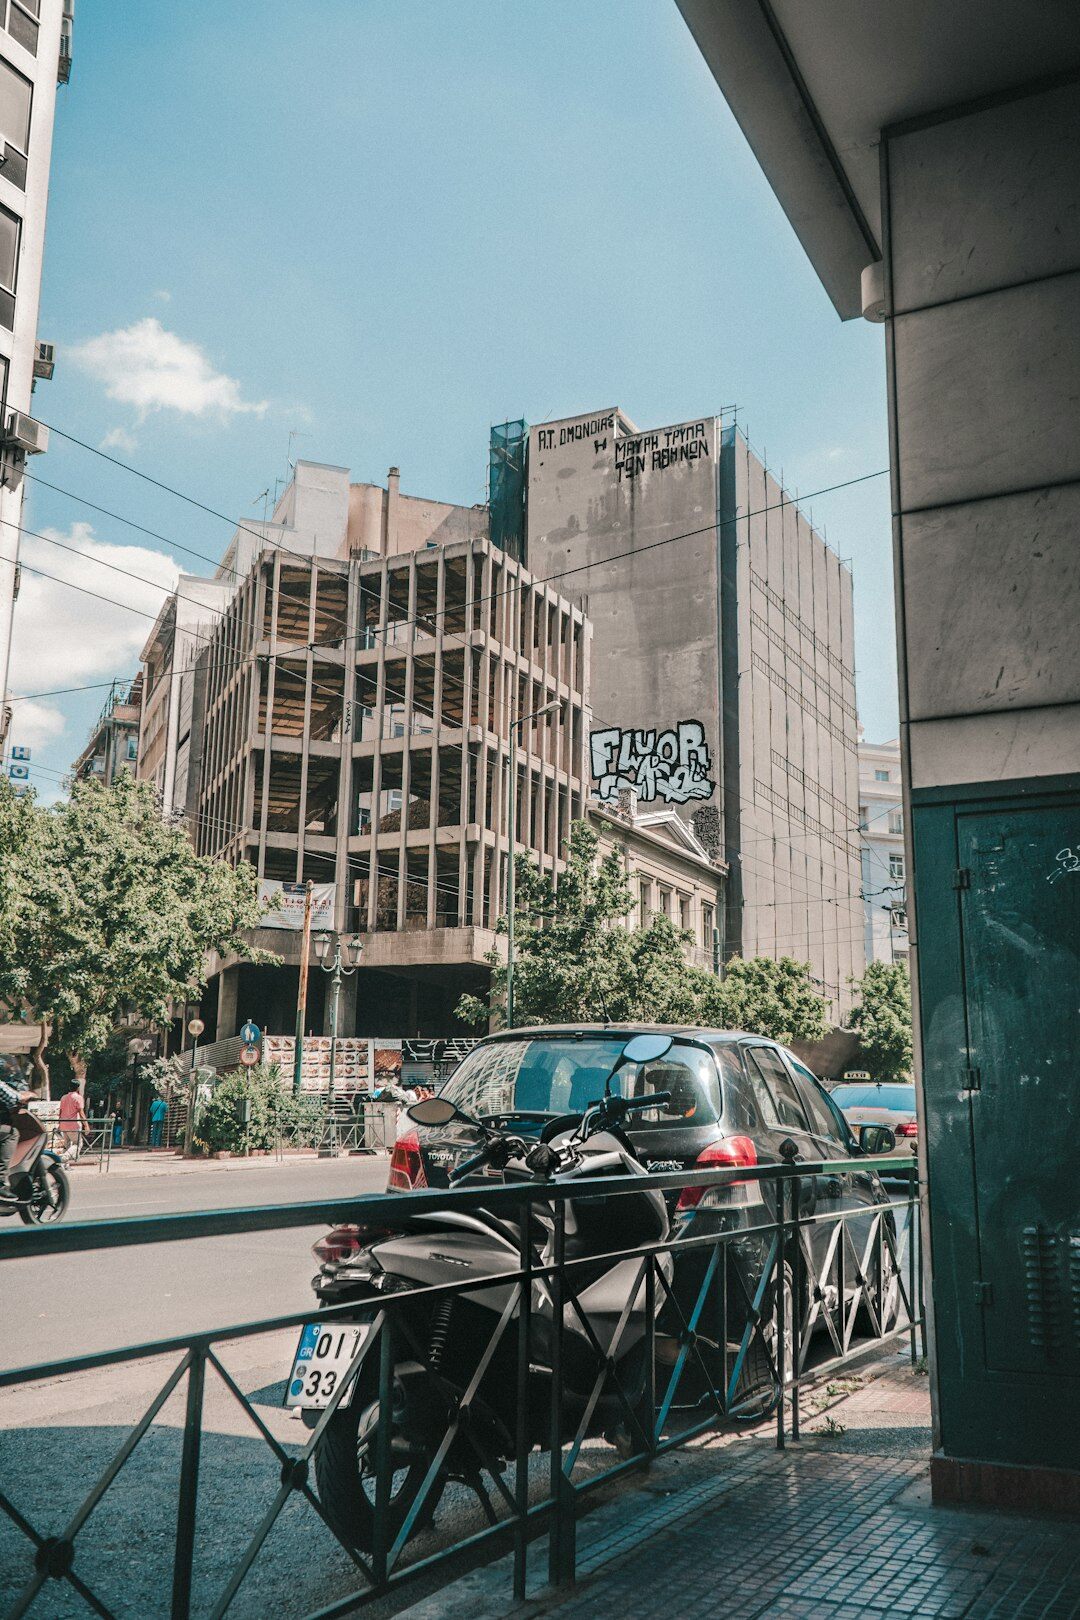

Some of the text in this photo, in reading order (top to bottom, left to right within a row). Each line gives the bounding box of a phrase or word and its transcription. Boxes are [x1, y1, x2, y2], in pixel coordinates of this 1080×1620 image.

[615, 436, 659, 462] ΜΑΥΡΗ
[665, 423, 705, 448] ΤΡΥΠΑ
[427, 1152, 454, 1161] TOYOTA
[646, 1160, 685, 1171] YARIS
[300, 1347, 313, 1357] GR
[305, 1370, 348, 1396] 33
